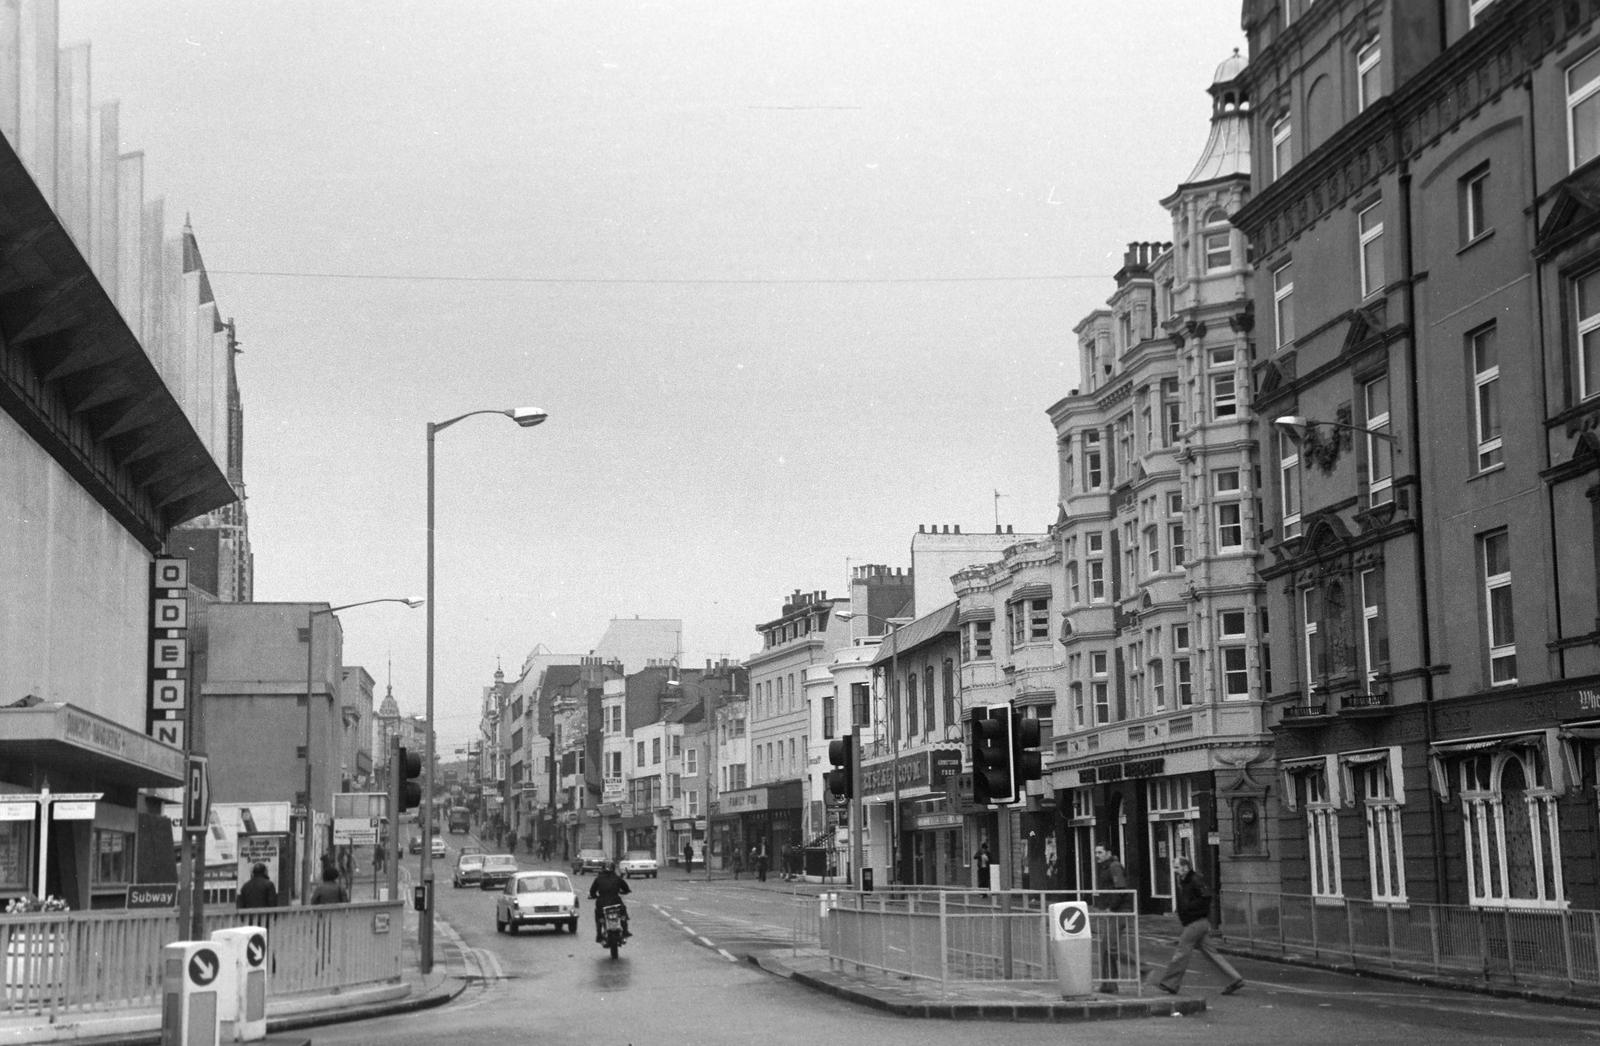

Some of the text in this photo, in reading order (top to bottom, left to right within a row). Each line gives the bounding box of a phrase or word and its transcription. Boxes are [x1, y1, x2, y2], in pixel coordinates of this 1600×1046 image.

[160, 564, 180, 744] ODEON
[191, 768, 201, 820] P
[131, 891, 173, 905] Subway
